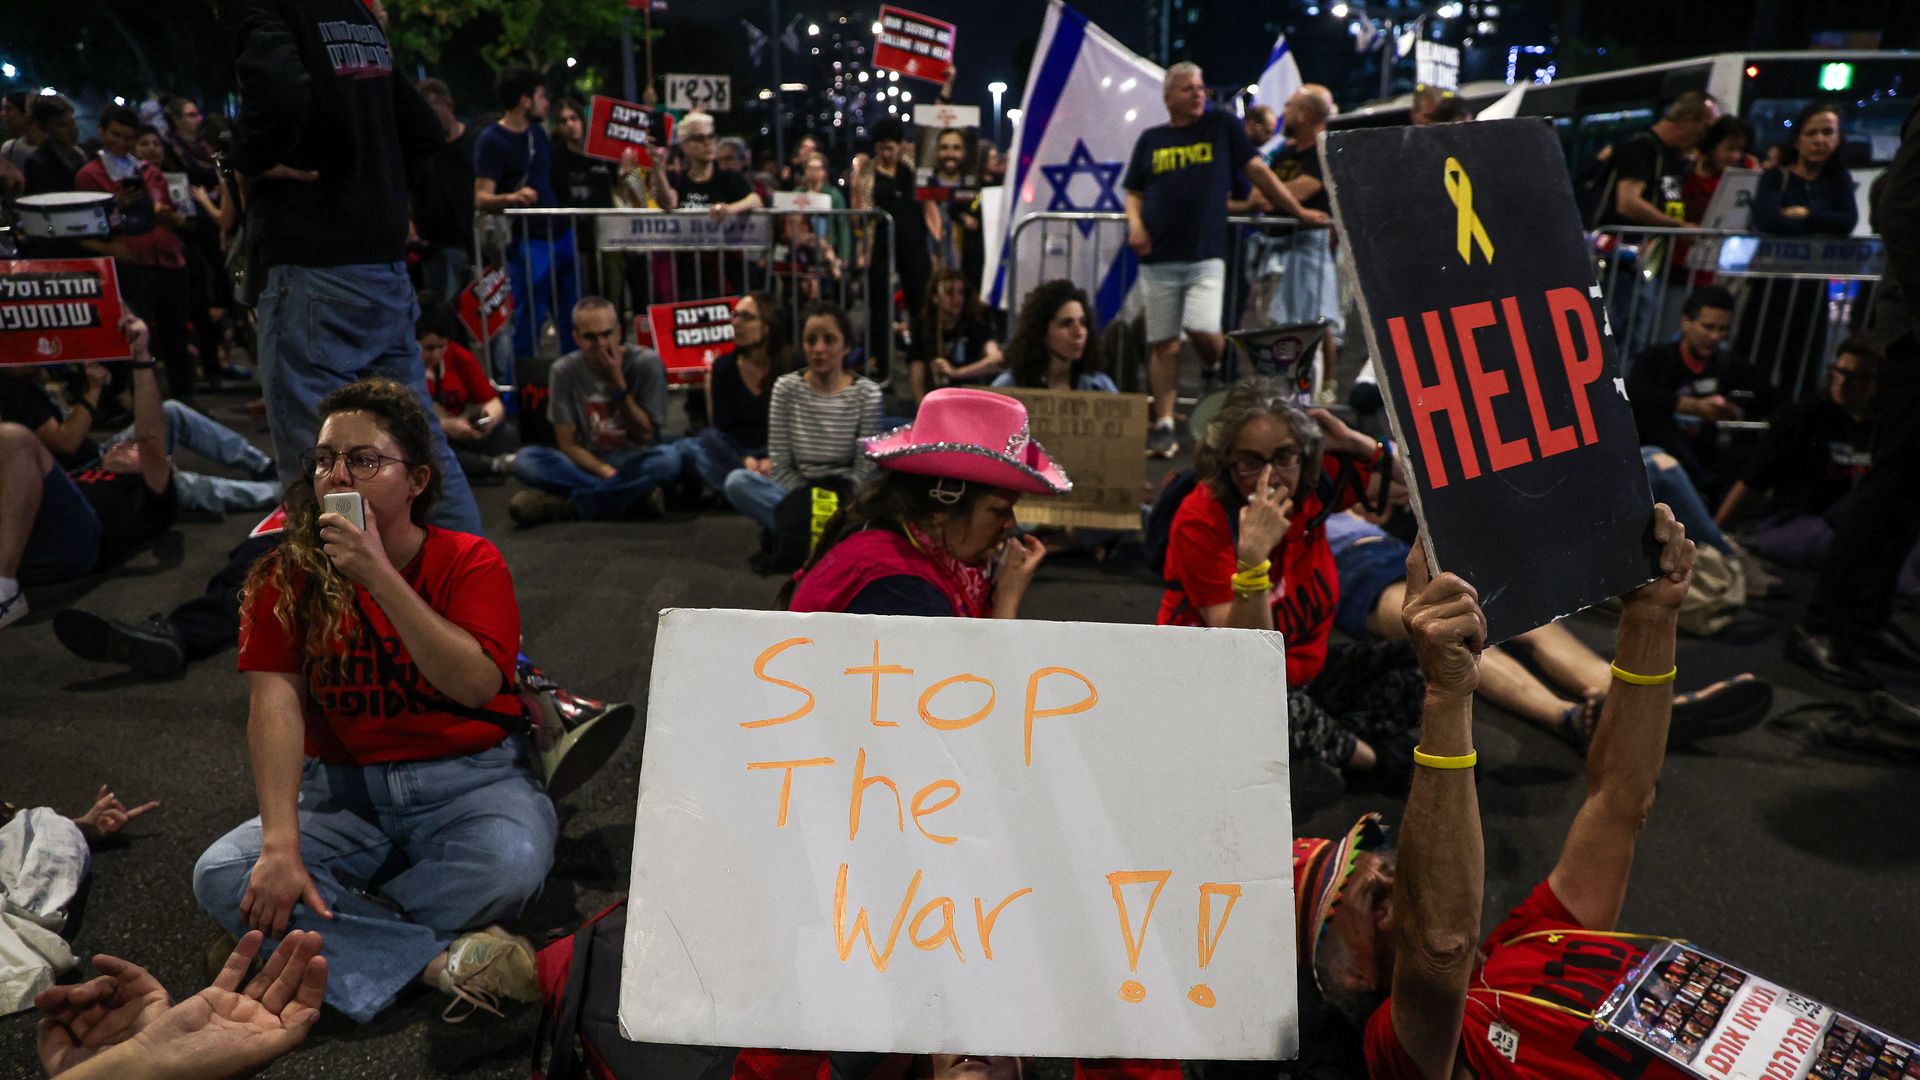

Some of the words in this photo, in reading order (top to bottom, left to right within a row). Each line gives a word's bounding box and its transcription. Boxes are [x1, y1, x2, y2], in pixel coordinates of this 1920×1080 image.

[44, 278, 98, 296] תודה
[675, 304, 730, 325] מדינה
[675, 323, 735, 346] חטופה
[1386, 287, 1604, 490] HELP
[740, 637, 1099, 766] Stop
[746, 747, 963, 844] The
[834, 862, 1032, 972] War
[1732, 985, 1777, 1031] תוציאו
